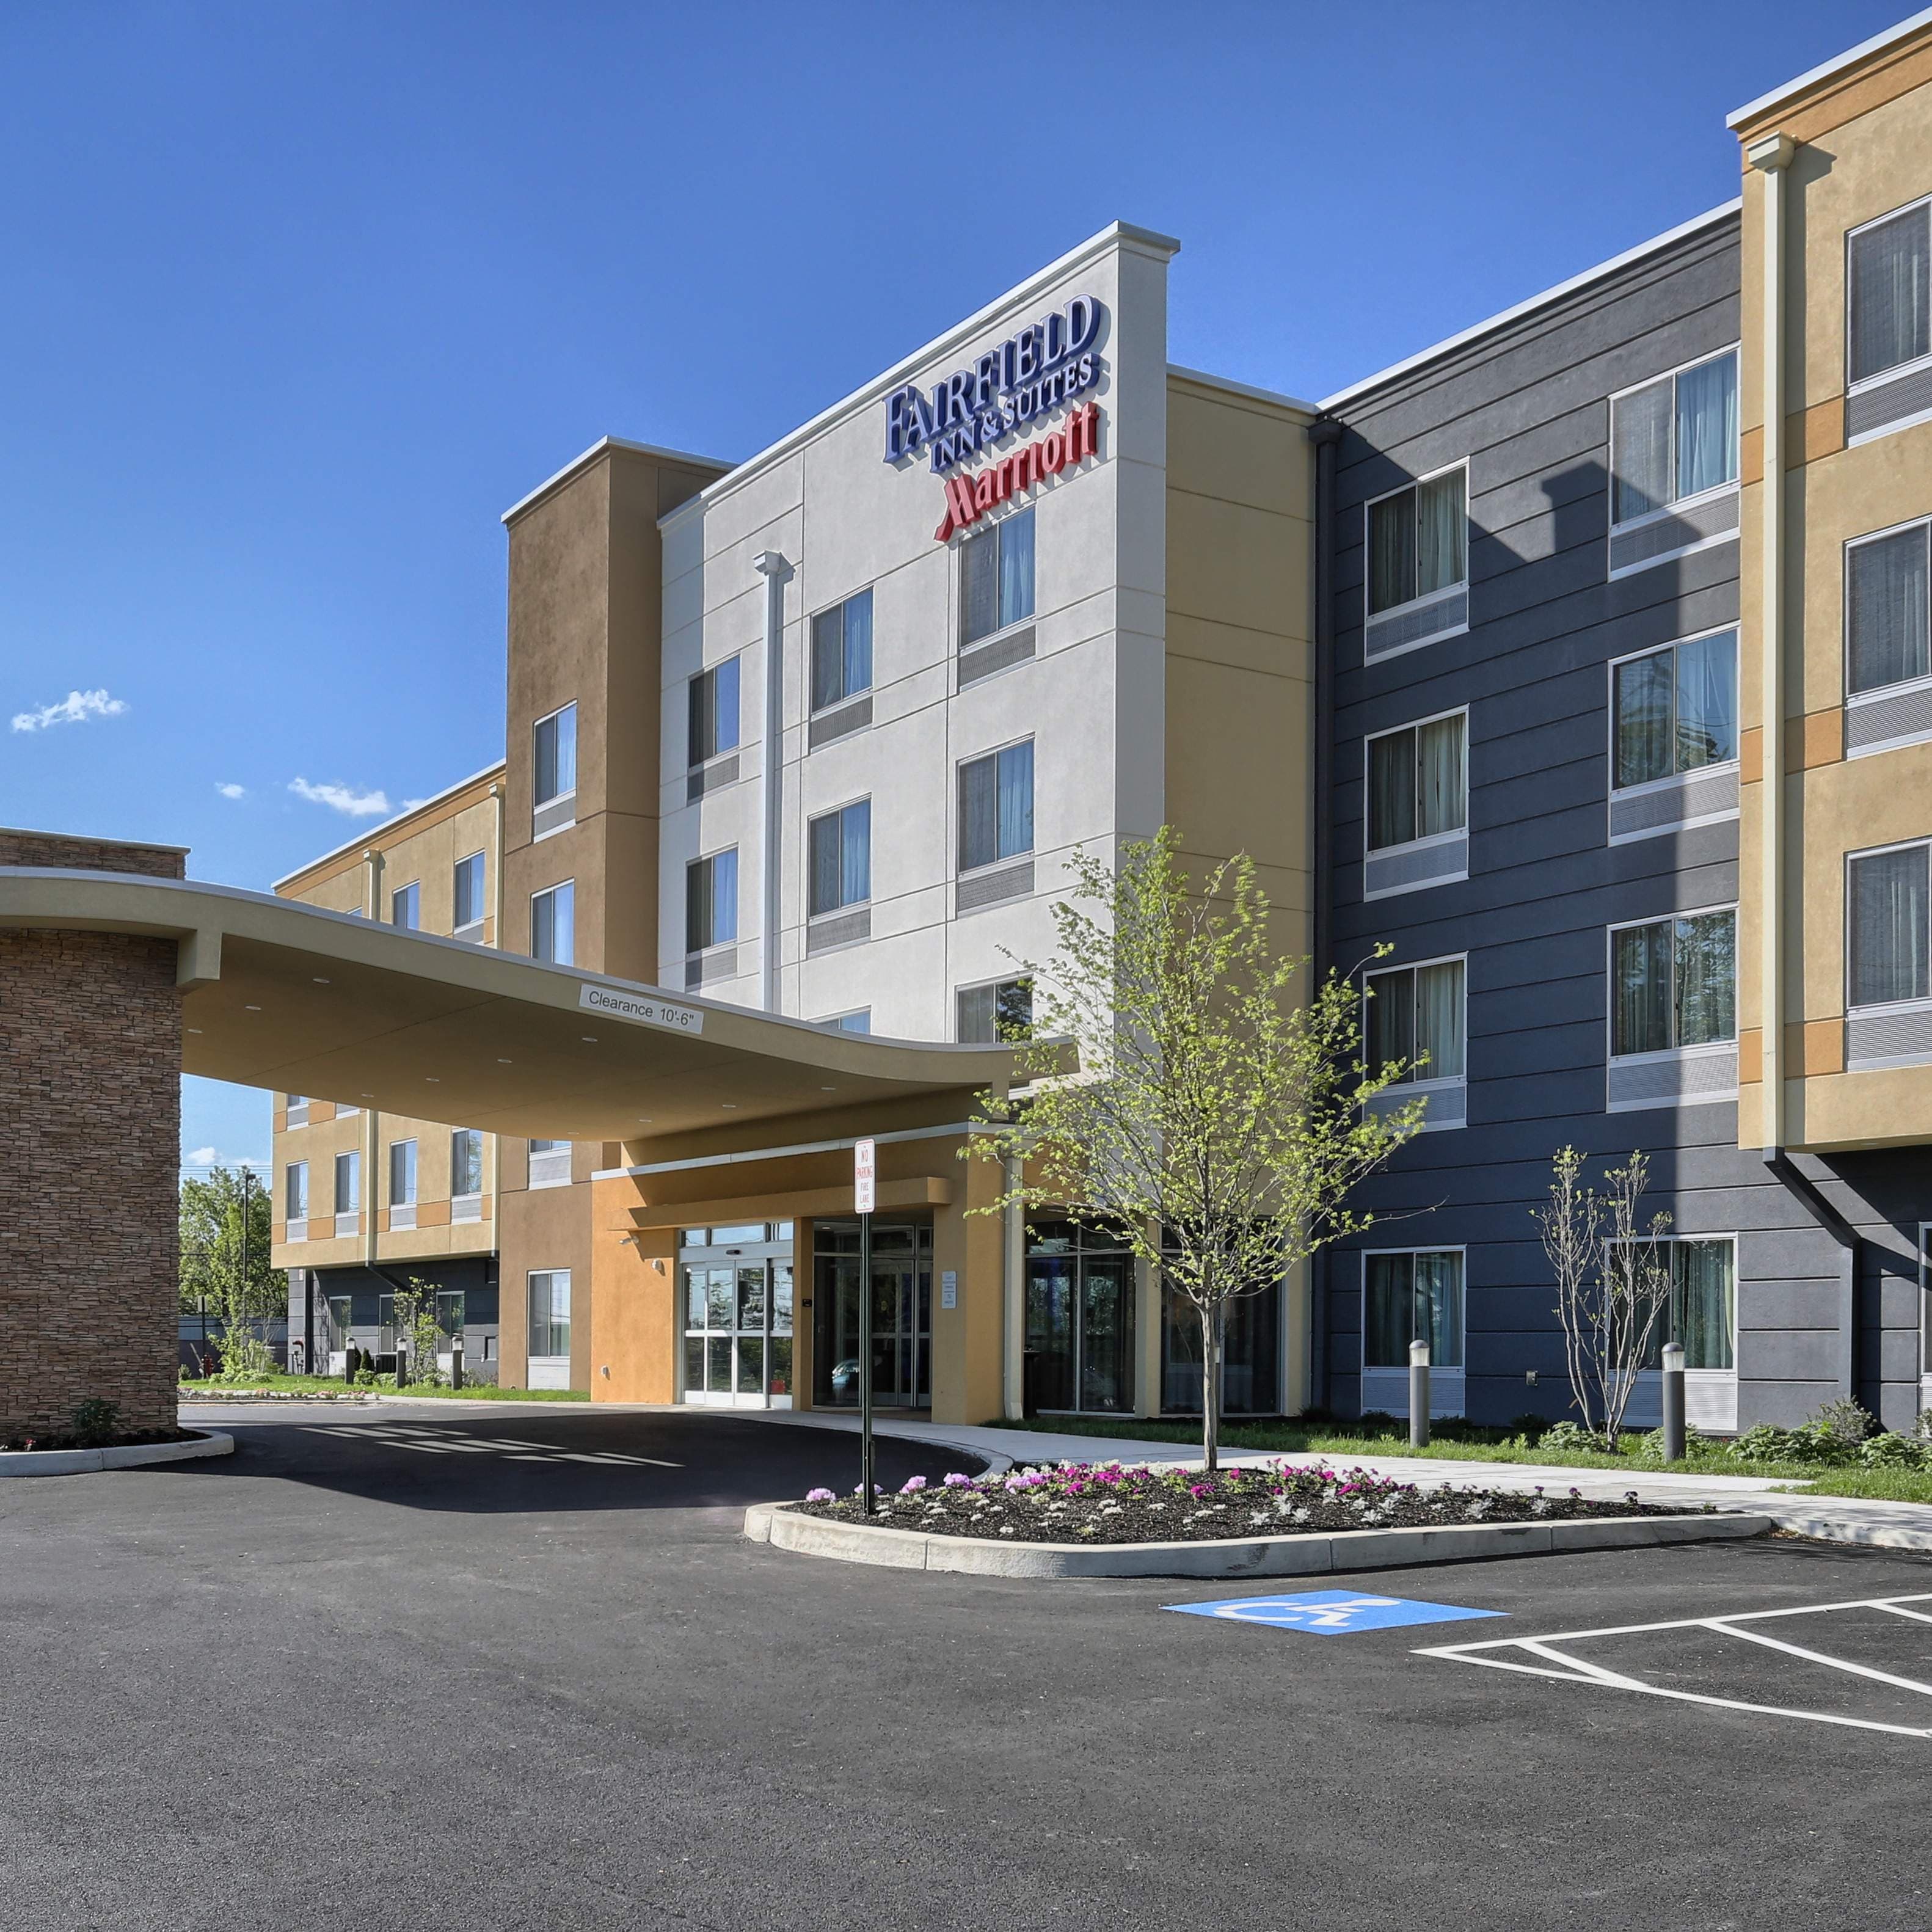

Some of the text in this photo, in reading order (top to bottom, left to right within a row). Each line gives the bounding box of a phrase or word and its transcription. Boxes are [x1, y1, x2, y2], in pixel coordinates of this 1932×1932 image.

[882, 294, 1099, 464] FAIRFIELD
[930, 418, 982, 473] INN
[1003, 352, 1100, 431] SUITES
[934, 401, 1099, 542] Marriott
[589, 991, 694, 1026] Clearance 10'-6"
[861, 1149, 869, 1163] NO
